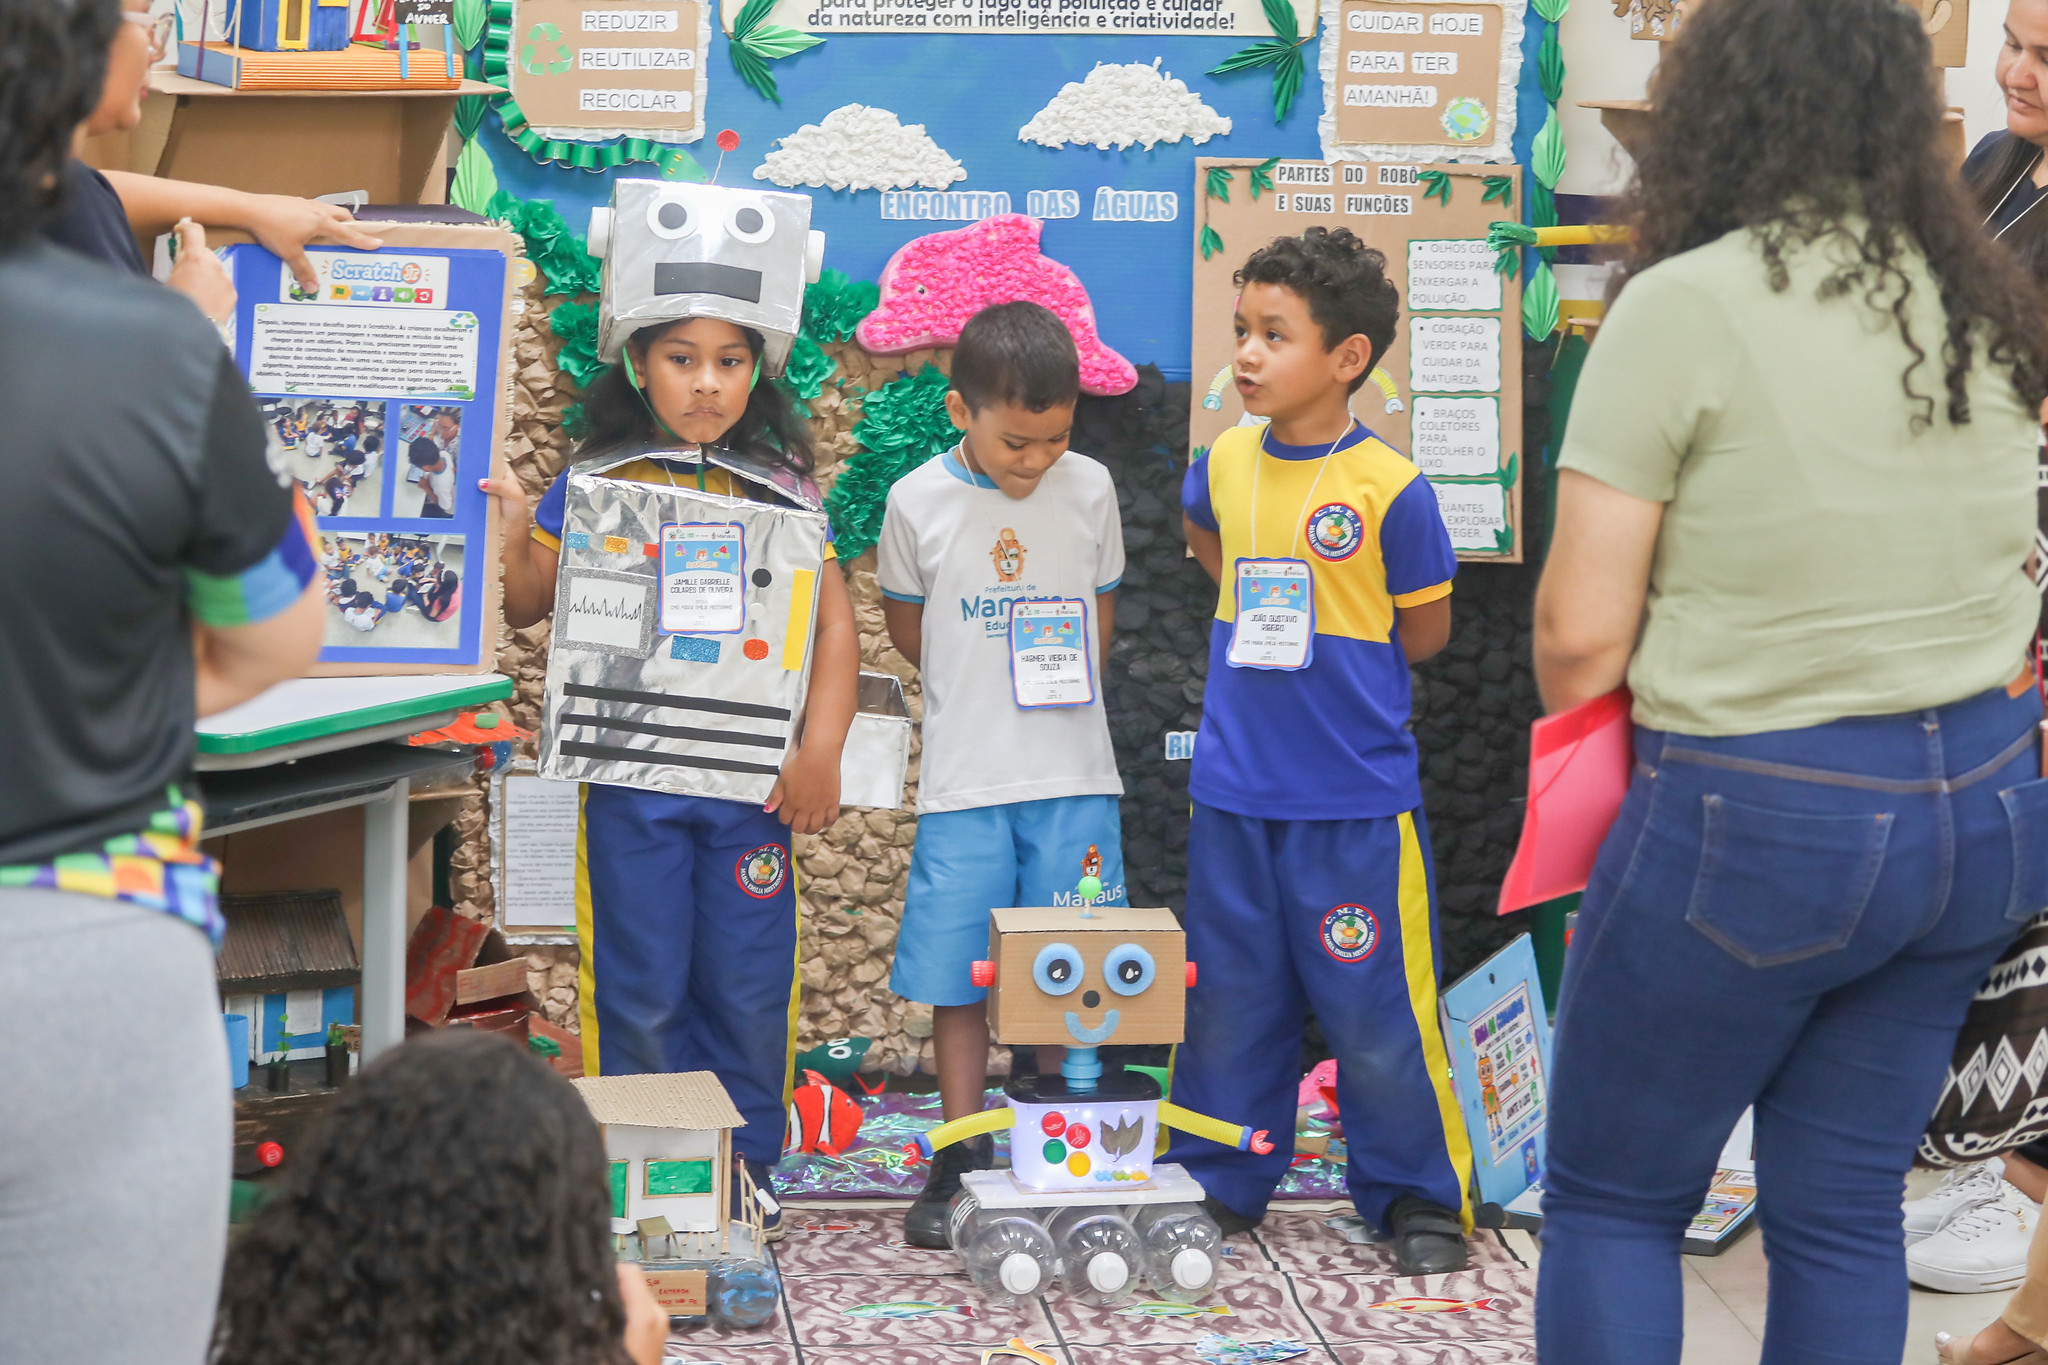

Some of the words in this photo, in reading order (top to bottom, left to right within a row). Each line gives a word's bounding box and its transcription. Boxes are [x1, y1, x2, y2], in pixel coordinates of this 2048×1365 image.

[417, 3, 431, 11] DO
[405, 13, 449, 24] AVNER
[584, 15, 667, 29] REDUZIR
[808, 9, 832, 26] da
[840, 11, 927, 26] natureza
[933, 14, 972, 26] com
[979, 10, 1090, 29] inteligência
[1097, 15, 1106, 27] e
[1113, 12, 1235, 29] criatividade!
[1350, 15, 1419, 31] CUIDAR
[1432, 18, 1479, 32] HOJE
[582, 52, 690, 67] REUTILIZAR
[1350, 56, 1399, 70] PARA
[1414, 57, 1450, 71] TER
[582, 93, 676, 109] RECICLAR
[1346, 88, 1429, 104] AMANHÃ!
[1279, 167, 1330, 182] PARTES
[1345, 168, 1363, 182] DO
[1380, 167, 1417, 184] ROBÔ
[885, 193, 1010, 219] ENCONTRO
[1030, 192, 1077, 218] DAS
[1098, 188, 1175, 219] ÁGUAS
[1278, 195, 1285, 210] E
[1295, 197, 1332, 212] SUAS
[1431, 244, 1466, 253] OLHOS
[1412, 260, 1465, 270] SENSORES
[1469, 261, 1495, 270] PARA
[1412, 277, 1469, 286] ENXERGAR
[1472, 278, 1479, 286] A
[1412, 292, 1470, 304] POLUIÇÃO.
[1432, 323, 1484, 336] CORAÇÃO
[1423, 341, 1457, 350] VERDE
[1461, 342, 1488, 351] PARA
[1422, 357, 1462, 367] CUIDAR
[1466, 358, 1481, 367] DA
[1422, 375, 1480, 384] NATUREZA.
[1433, 409, 1476, 420] BRAÇOS
[1419, 421, 1480, 431] COLETORES
[1419, 434, 1448, 442] PARA
[1419, 446, 1474, 456] RECOLHER
[1477, 447, 1486, 456] O
[1448, 515, 1501, 526] EXPLORAR
[1168, 734, 1191, 758] RI
[1053, 885, 1122, 907] Maaus
